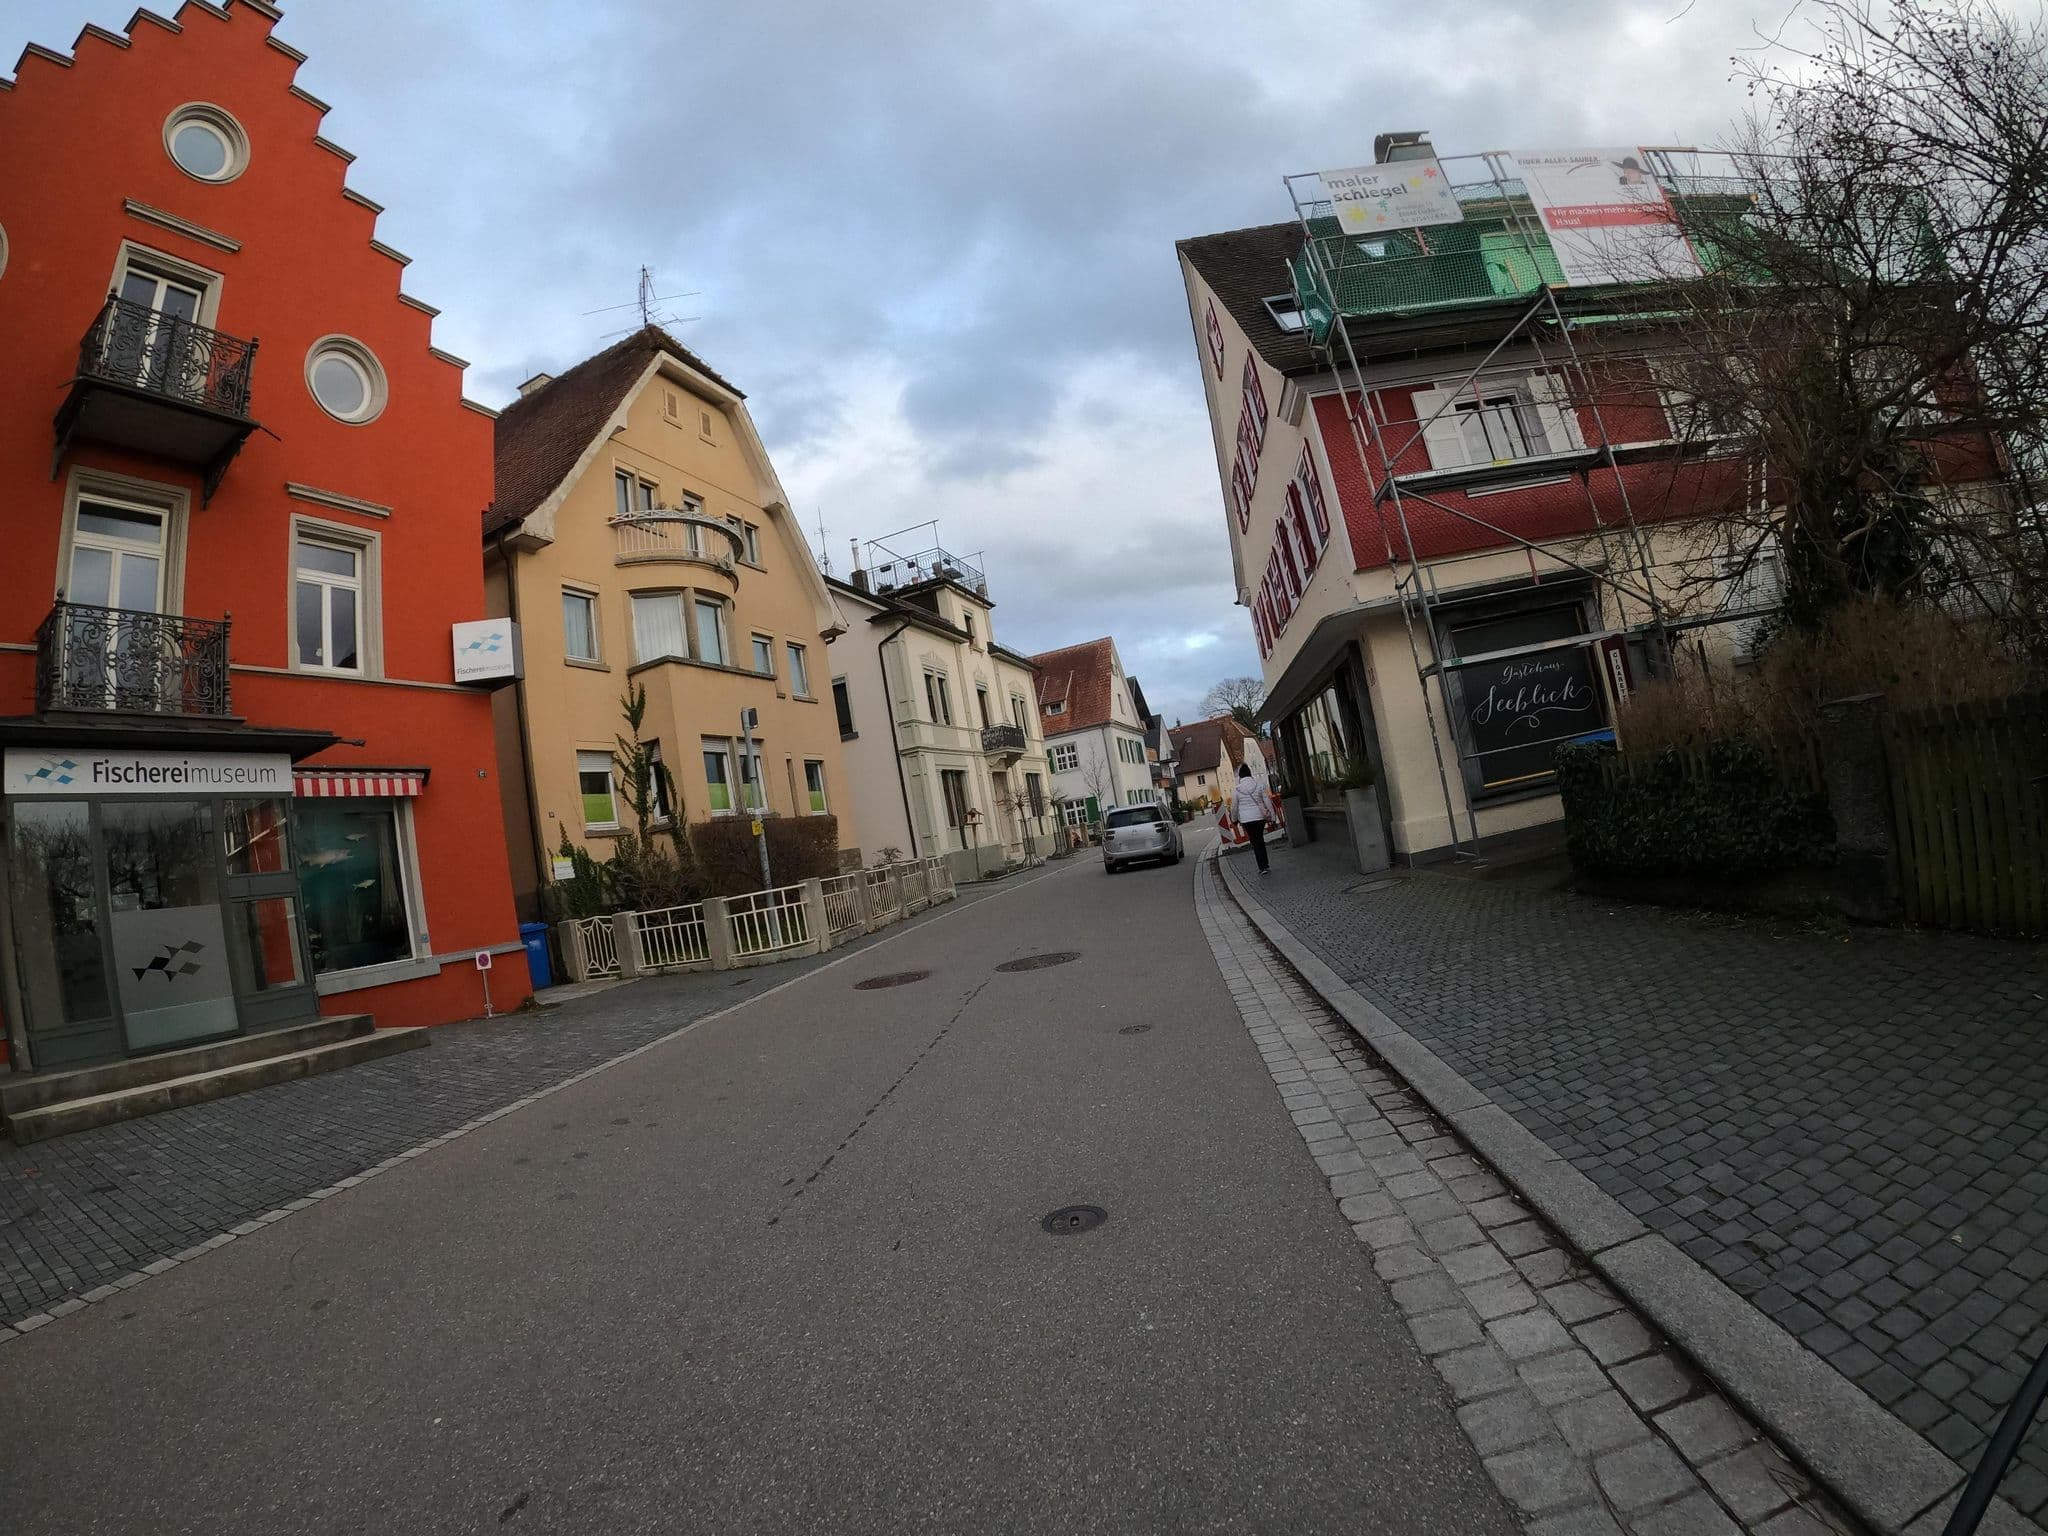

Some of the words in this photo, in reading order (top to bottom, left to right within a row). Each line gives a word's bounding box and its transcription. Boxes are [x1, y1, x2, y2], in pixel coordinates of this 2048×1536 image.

[1327, 174, 1380, 190] maler
[1333, 183, 1408, 202] schlegel
[1471, 676, 1593, 726] Seeblick
[92, 759, 276, 783] Fischereimuseum
